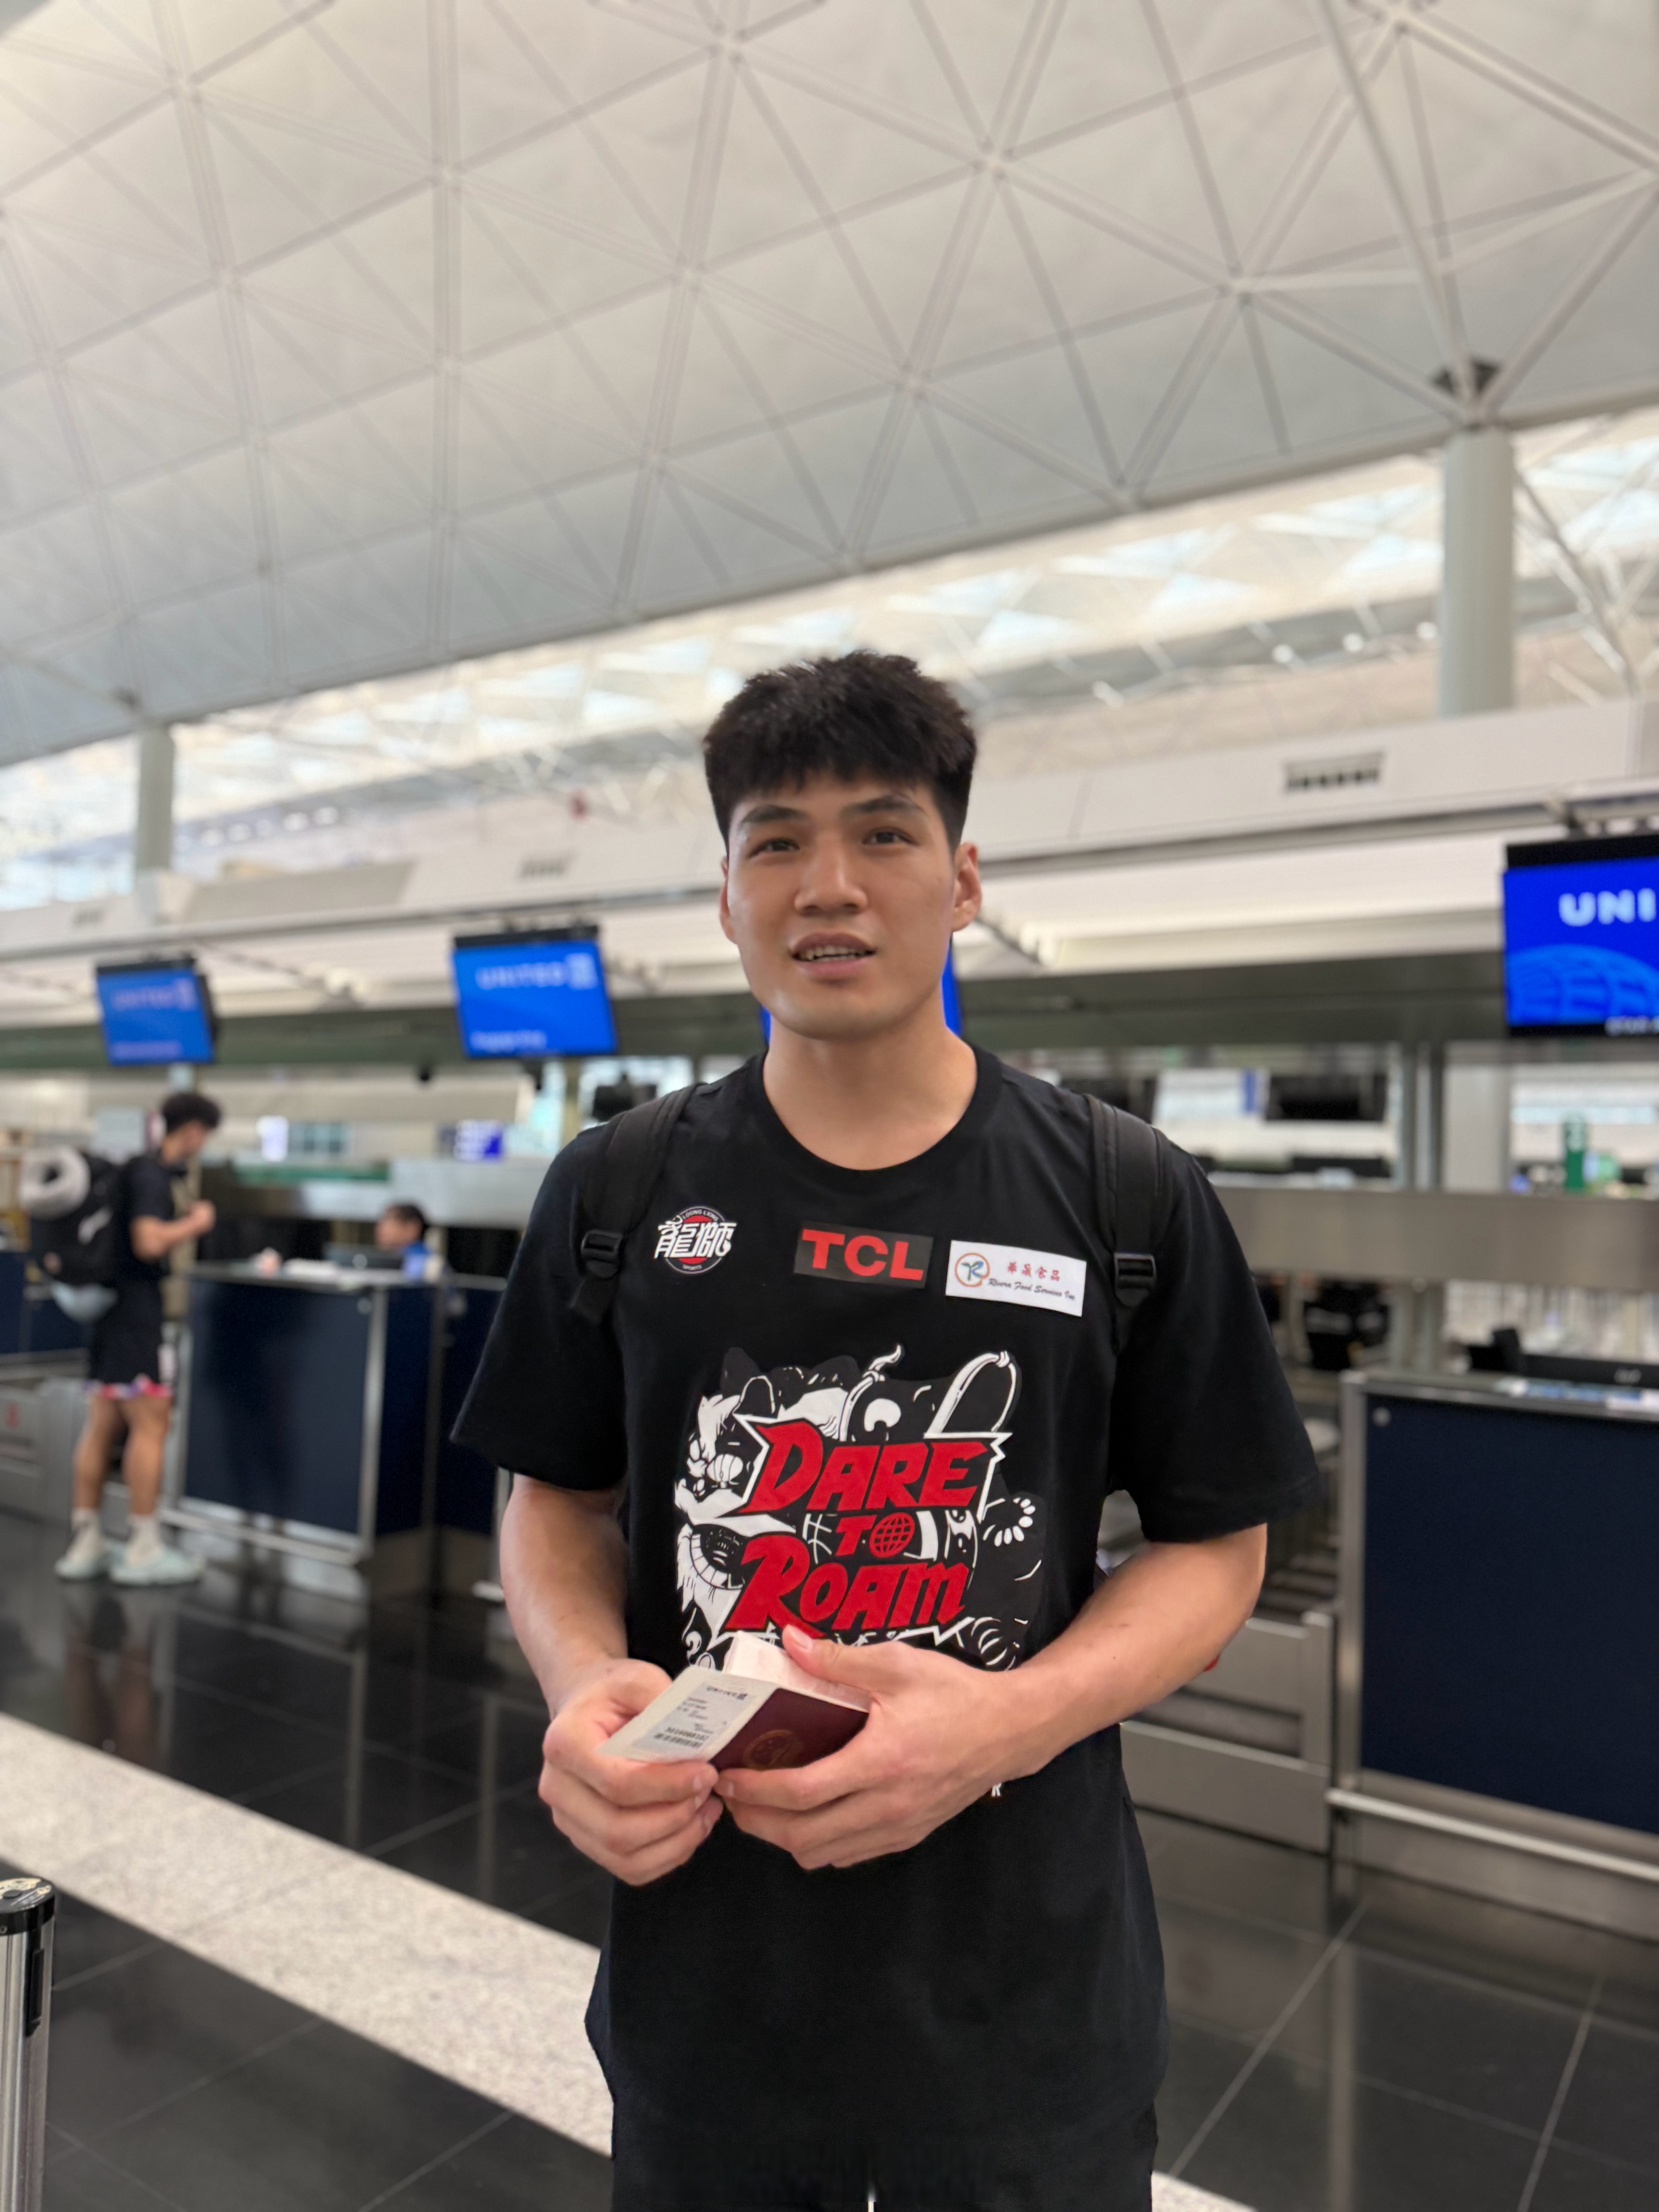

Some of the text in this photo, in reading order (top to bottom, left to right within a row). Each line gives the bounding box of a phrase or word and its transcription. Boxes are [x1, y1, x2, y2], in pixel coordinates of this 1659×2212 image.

[802, 1229, 924, 1281] TCL
[737, 1421, 988, 1514] DARE
[725, 1535, 970, 1639] ROAM
